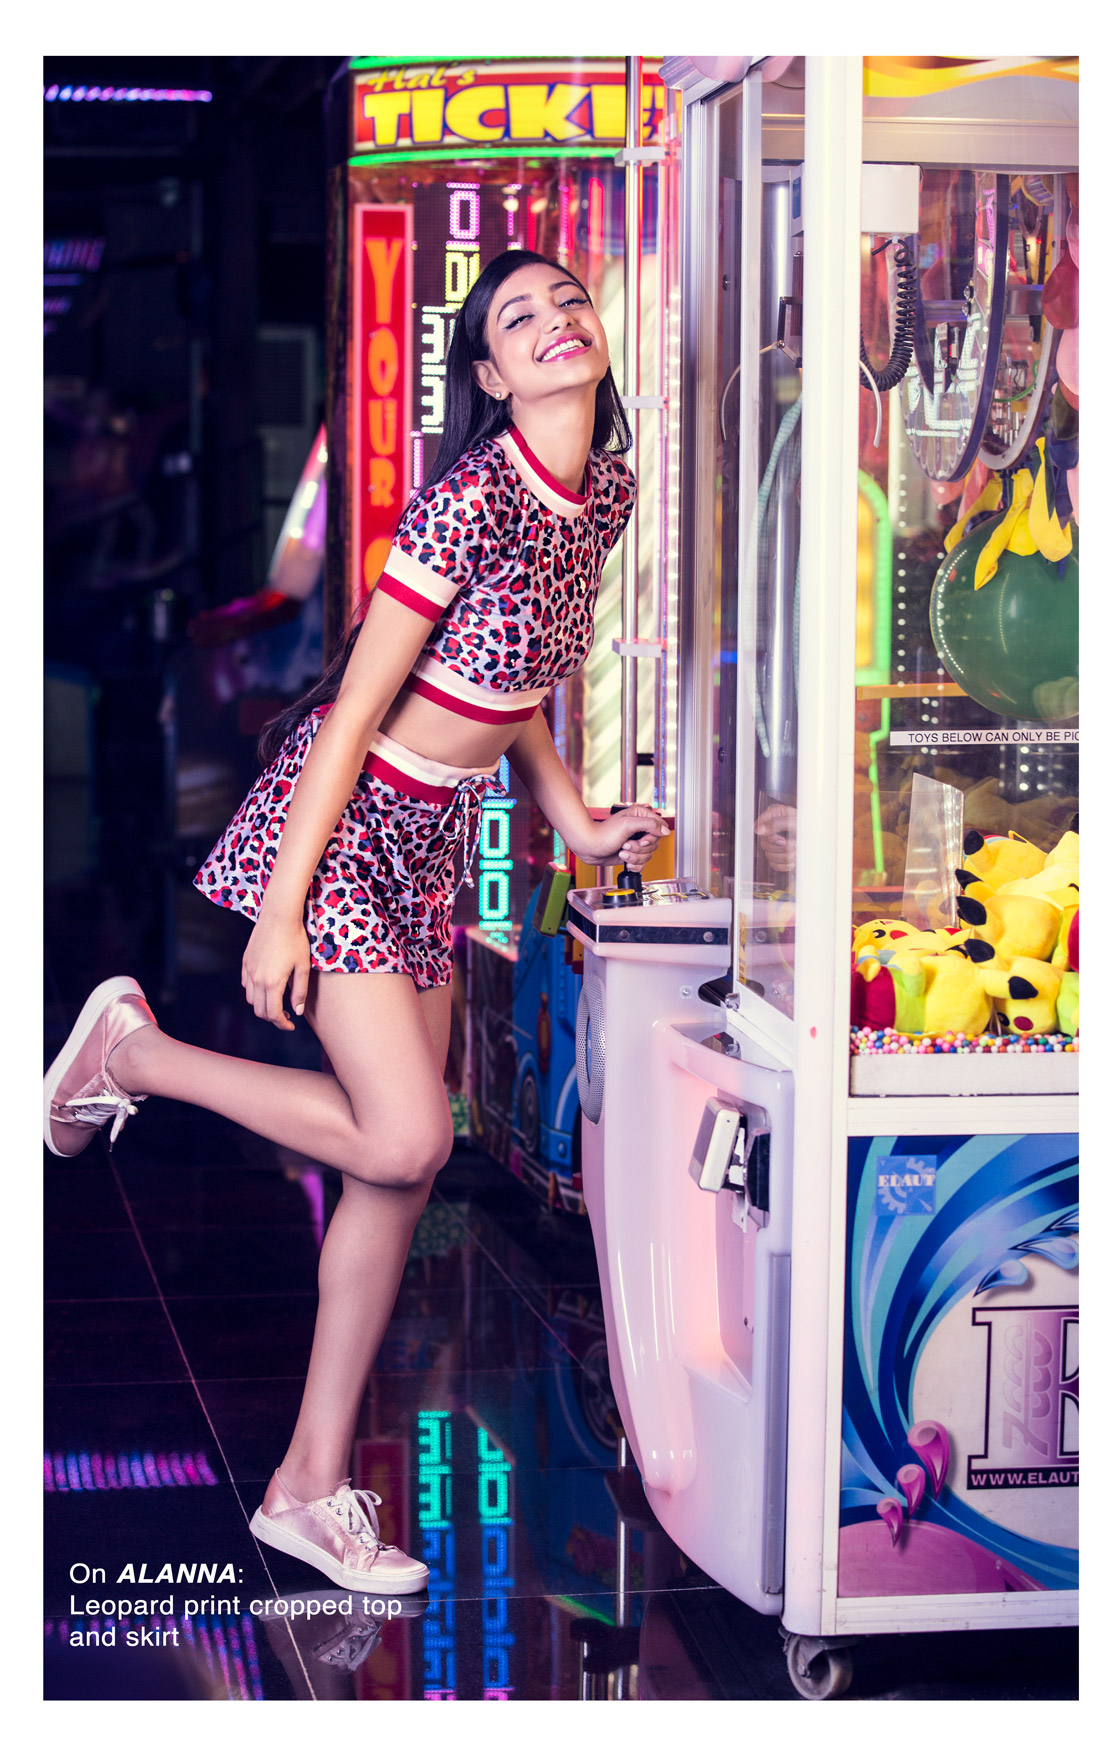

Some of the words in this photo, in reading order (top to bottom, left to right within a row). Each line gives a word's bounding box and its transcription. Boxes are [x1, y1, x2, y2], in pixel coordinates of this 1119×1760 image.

[366, 61, 477, 93] Hal's
[363, 83, 665, 147] TICKE
[364, 237, 404, 508] YOUR
[908, 733, 939, 743] TOYS
[942, 732, 983, 743] BELOW
[985, 732, 1010, 743] CAN
[1012, 731, 1043, 742] ONLY
[1046, 731, 1060, 741] BE
[878, 1174, 937, 1188] ELAUT
[970, 1471, 1079, 1487] WWW.ELAUT
